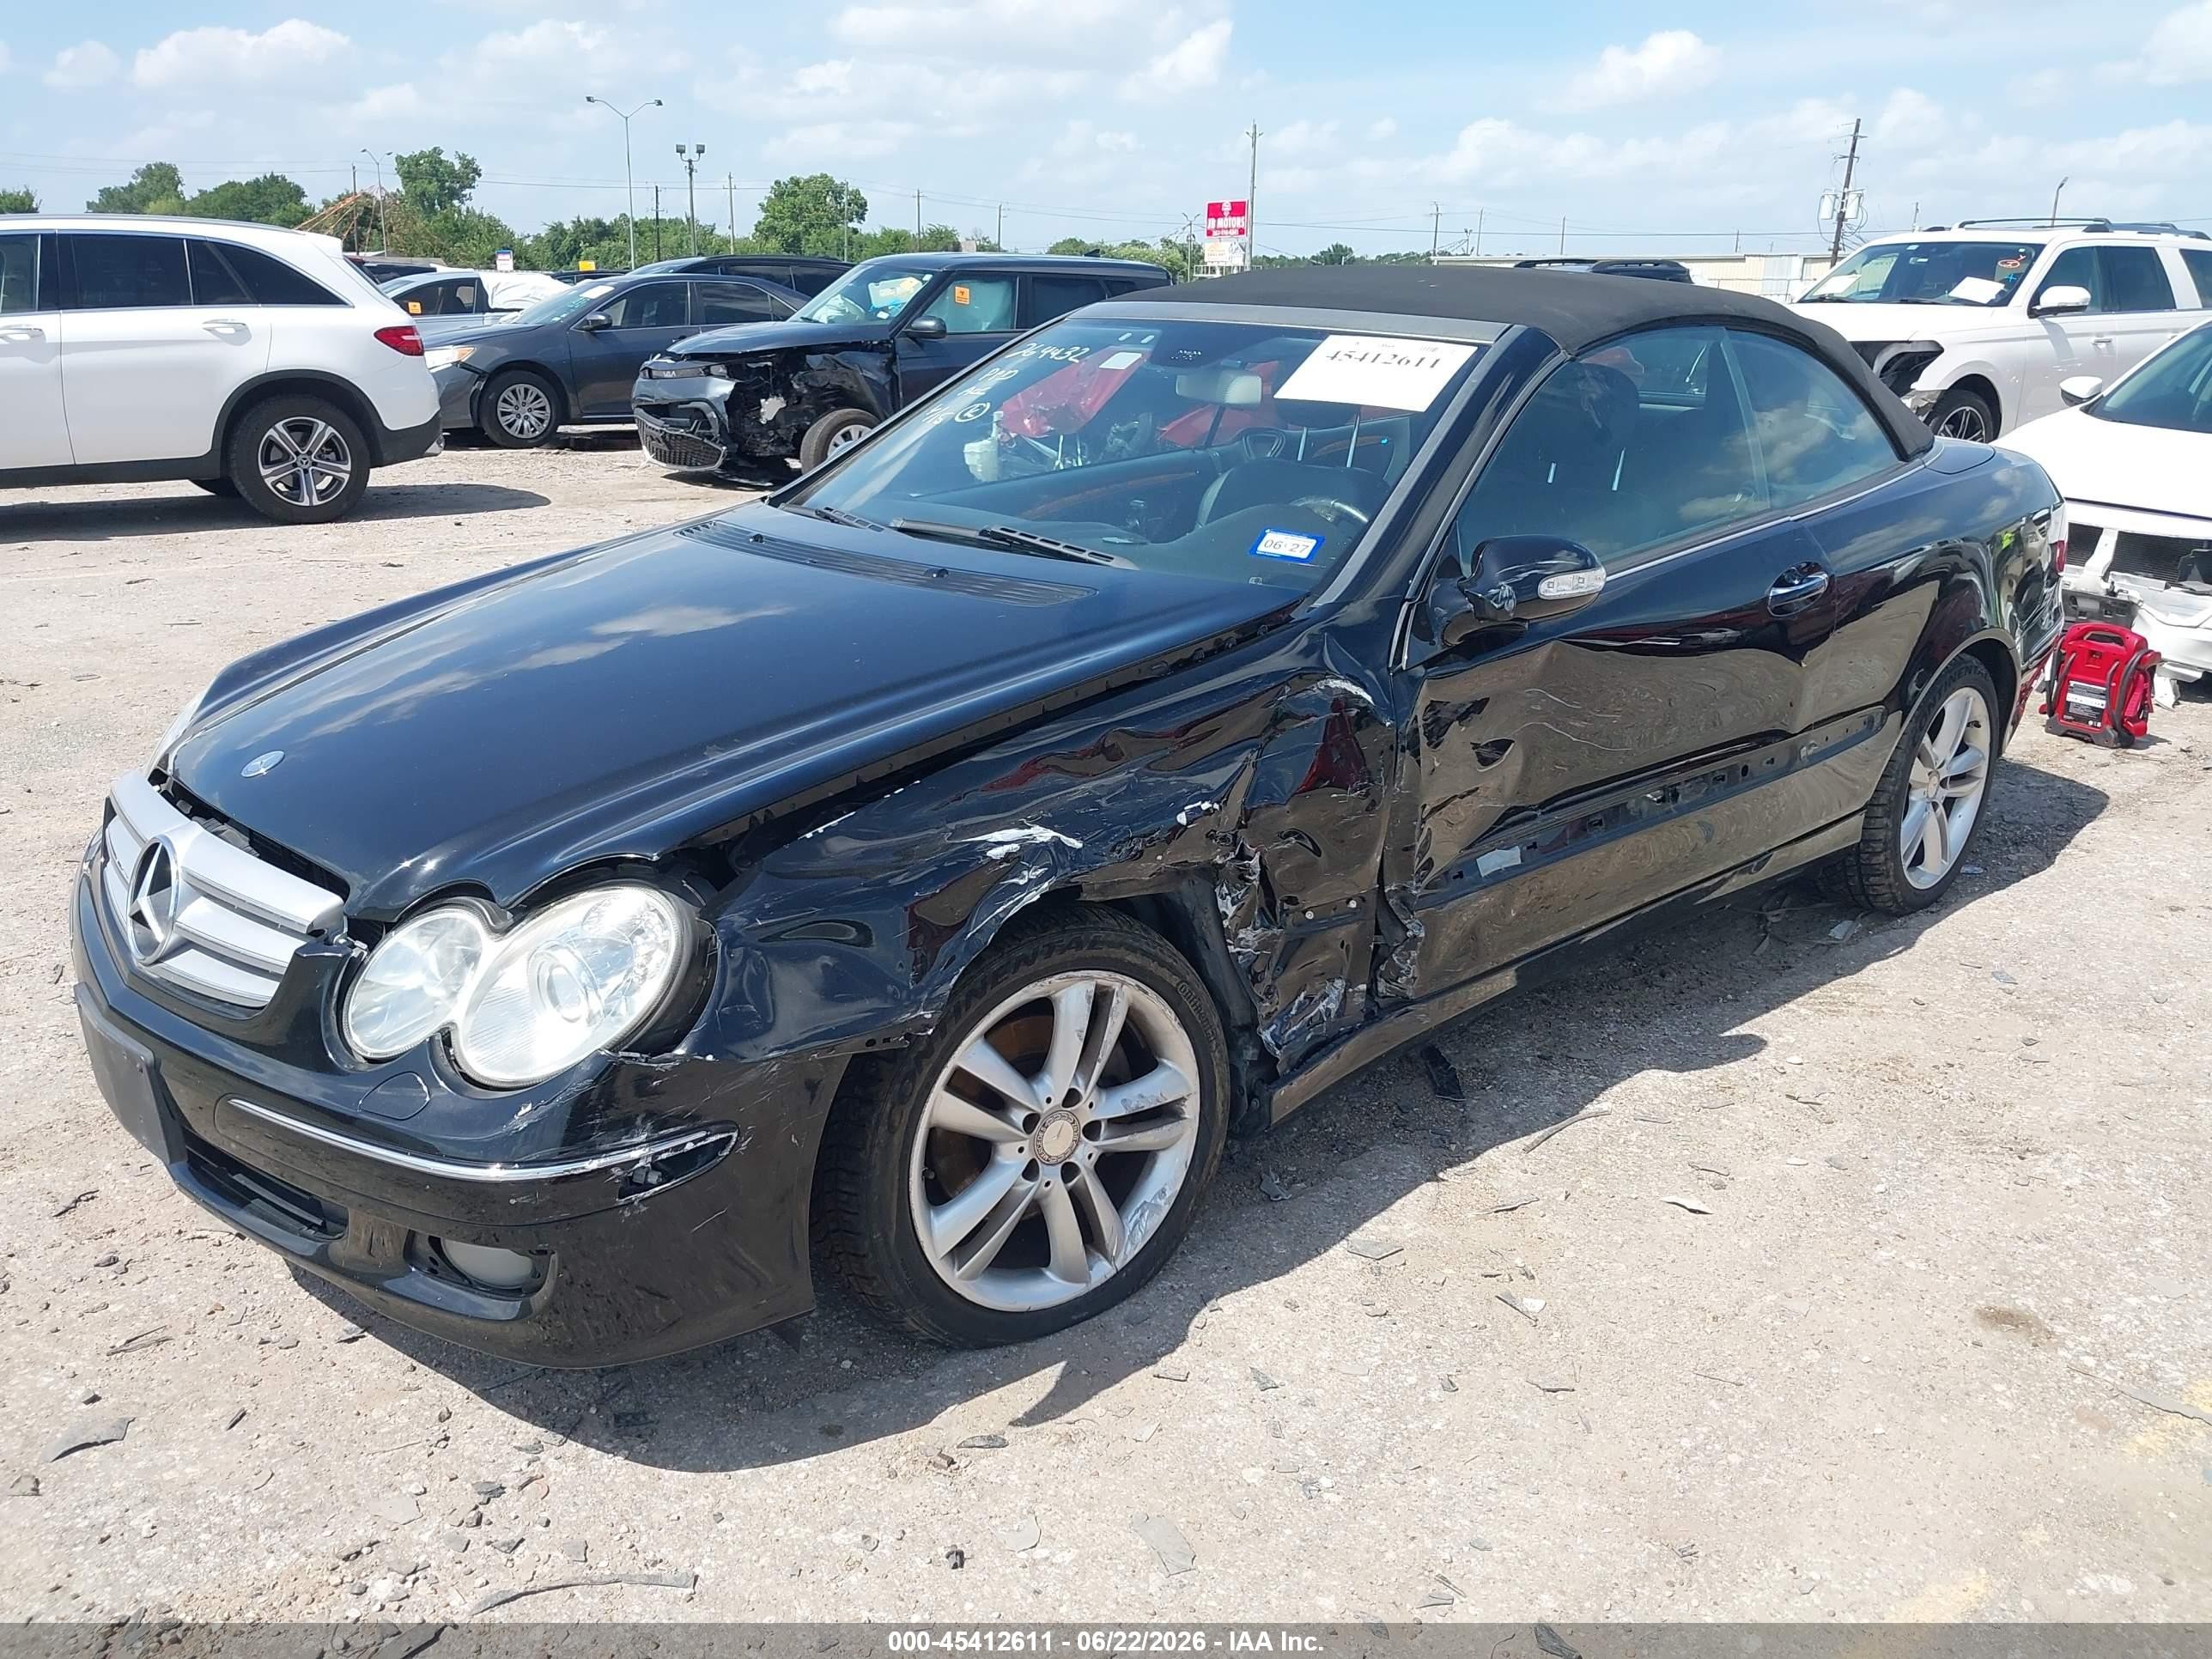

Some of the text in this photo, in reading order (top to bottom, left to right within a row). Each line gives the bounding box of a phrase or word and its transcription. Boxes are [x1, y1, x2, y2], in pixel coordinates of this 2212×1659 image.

[1217, 216, 1245, 228] MOTORS
[1326, 349, 1442, 369] 45412611
[1263, 538, 1310, 554] 06 27
